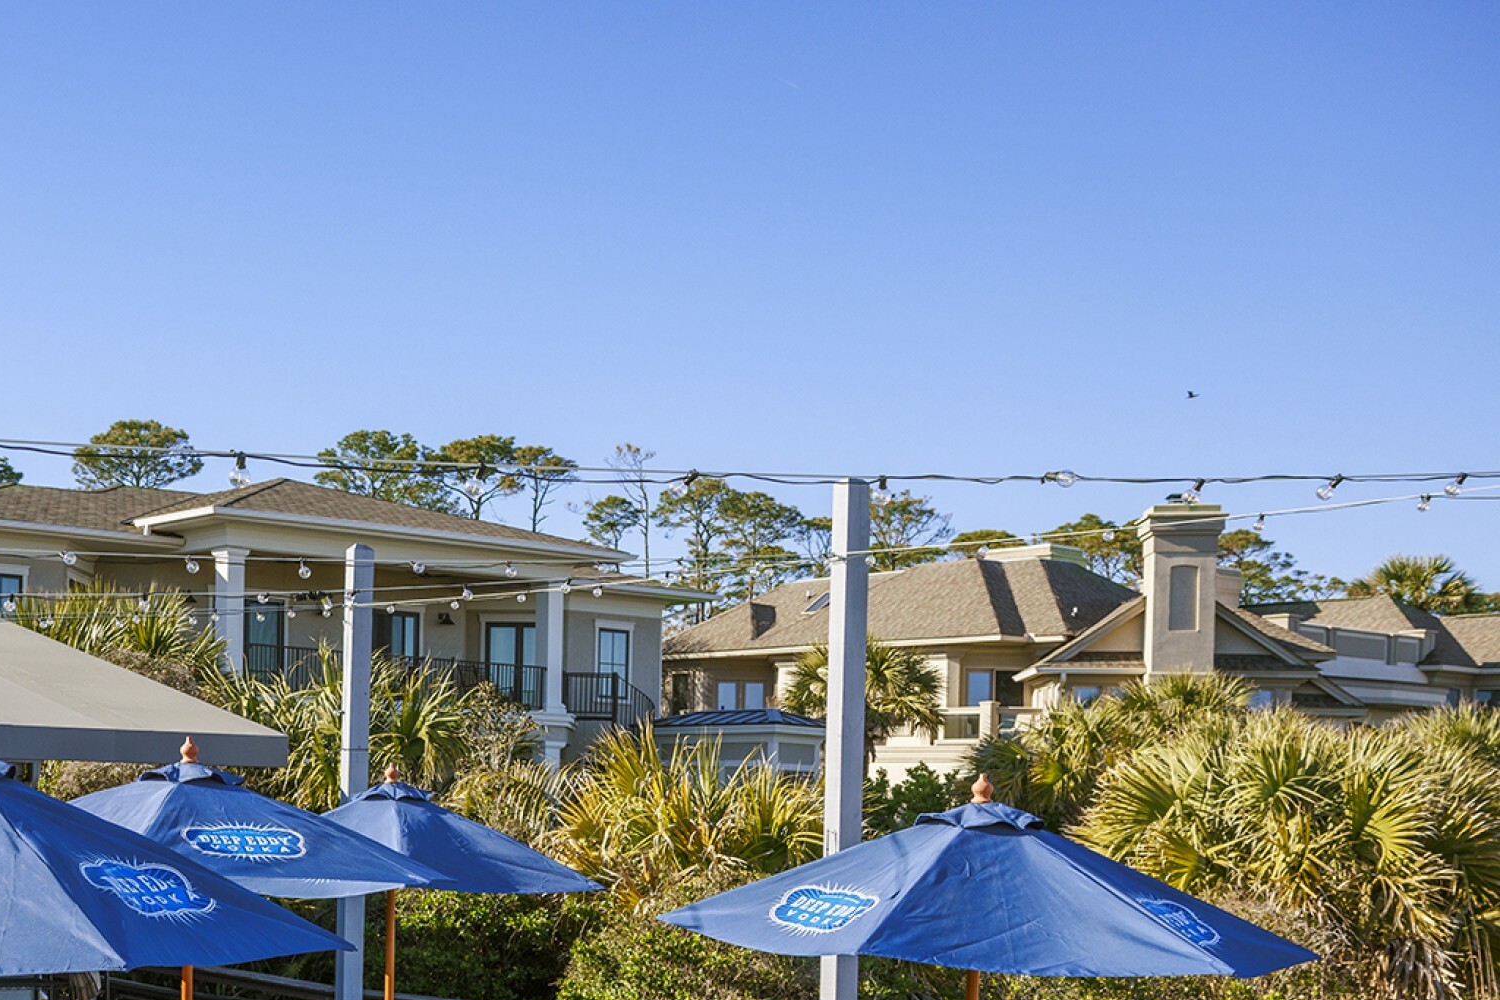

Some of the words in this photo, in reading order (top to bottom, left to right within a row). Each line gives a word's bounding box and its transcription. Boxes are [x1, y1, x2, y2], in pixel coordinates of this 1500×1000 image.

[198, 834, 241, 845] DEEP
[244, 835, 292, 845] EDDY
[210, 844, 291, 853] VODKA
[790, 896, 831, 913] DEEP
[787, 909, 845, 925] VODKA
